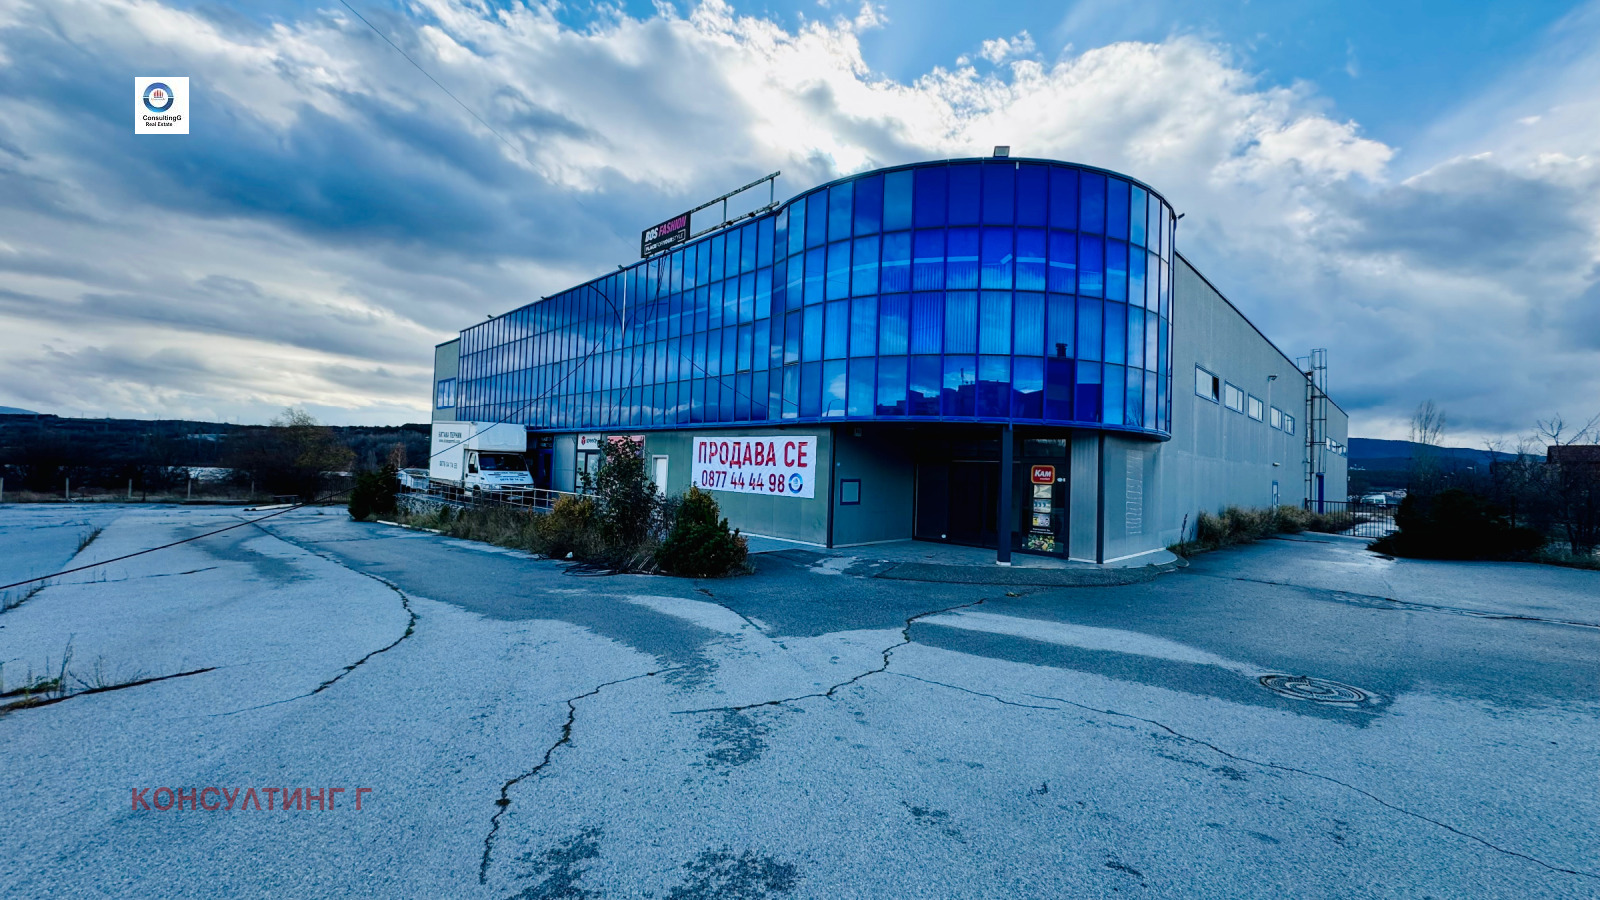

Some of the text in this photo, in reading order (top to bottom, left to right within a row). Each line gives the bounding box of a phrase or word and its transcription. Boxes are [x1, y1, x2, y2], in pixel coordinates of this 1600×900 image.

[658, 215, 687, 237] FASHION
[698, 441, 808, 469] ПРОДАВА СЕ
[702, 470, 785, 492] 0877 44 44 98
